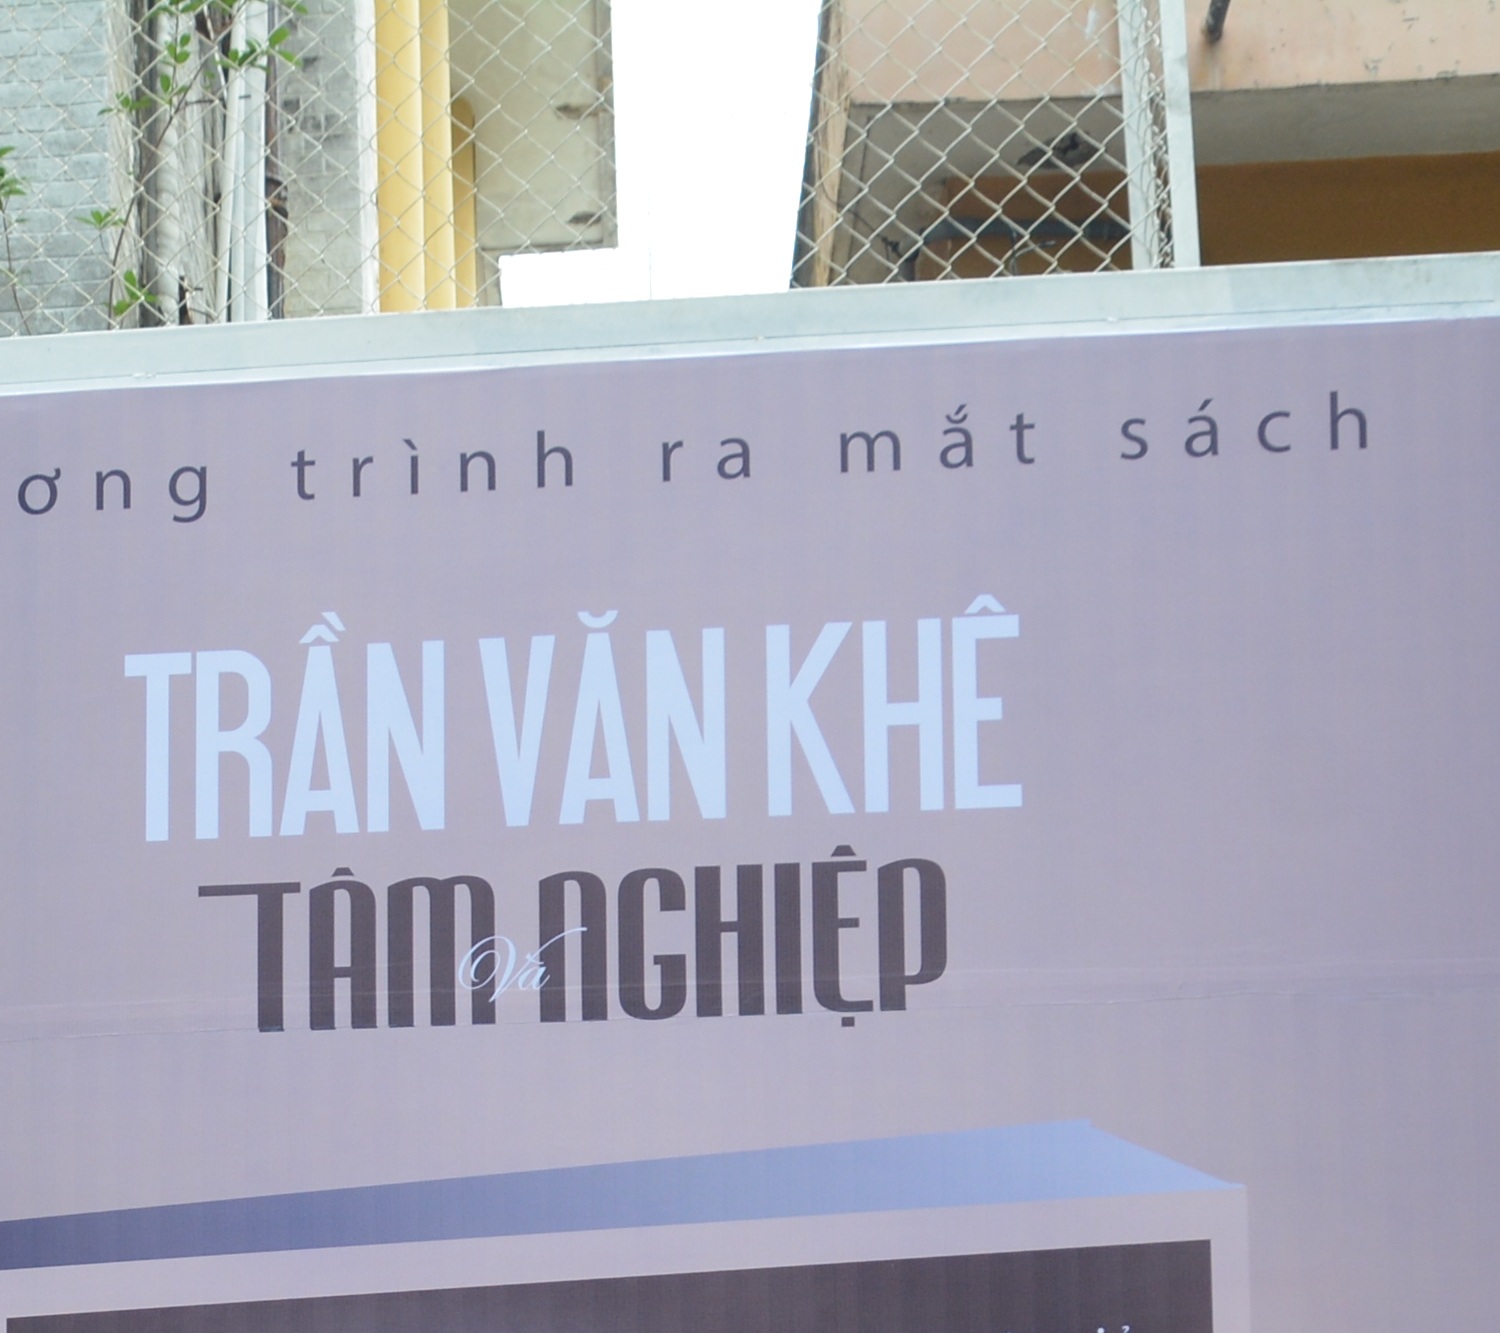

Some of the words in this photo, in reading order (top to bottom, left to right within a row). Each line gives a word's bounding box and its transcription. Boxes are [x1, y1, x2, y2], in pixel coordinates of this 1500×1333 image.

[290, 429, 576, 501] trình
[660, 436, 753, 484] ra
[838, 403, 1037, 474] mắt
[1119, 390, 1370, 460] sách
[124, 611, 446, 842] TRẦN
[479, 610, 728, 827] VĂN
[766, 594, 1024, 817] KHÊ
[198, 866, 496, 1033] TÂM
[538, 844, 948, 1028] NGHIỆP
